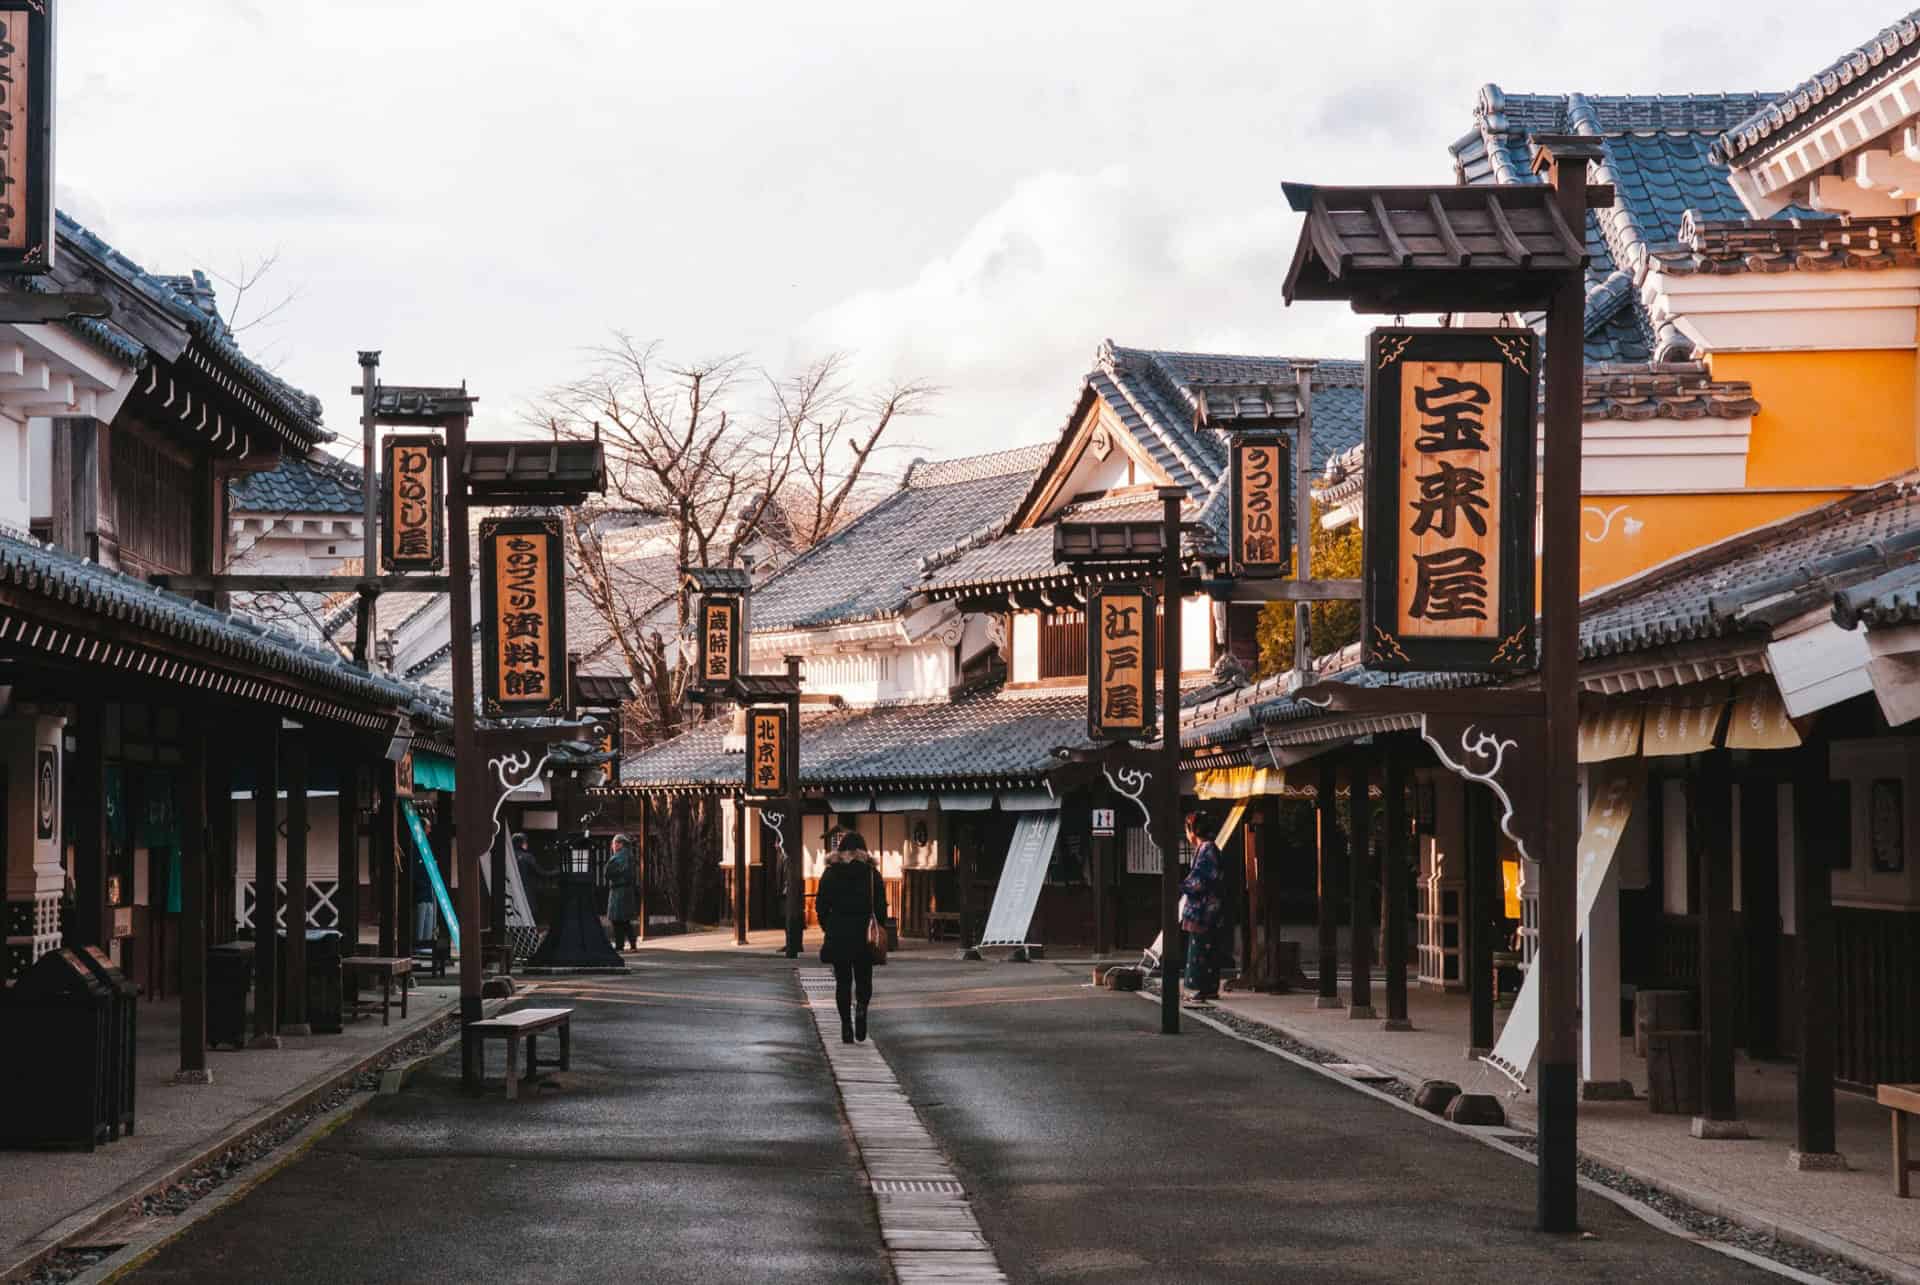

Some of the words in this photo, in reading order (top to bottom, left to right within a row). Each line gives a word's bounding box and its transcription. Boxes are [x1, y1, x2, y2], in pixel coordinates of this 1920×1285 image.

[1408, 377, 1491, 620] 宝来屋
[502, 537, 546, 695] ものづくり資料館
[1104, 604, 1140, 720] 江戸屋
[758, 720, 776, 785] 北京亭
